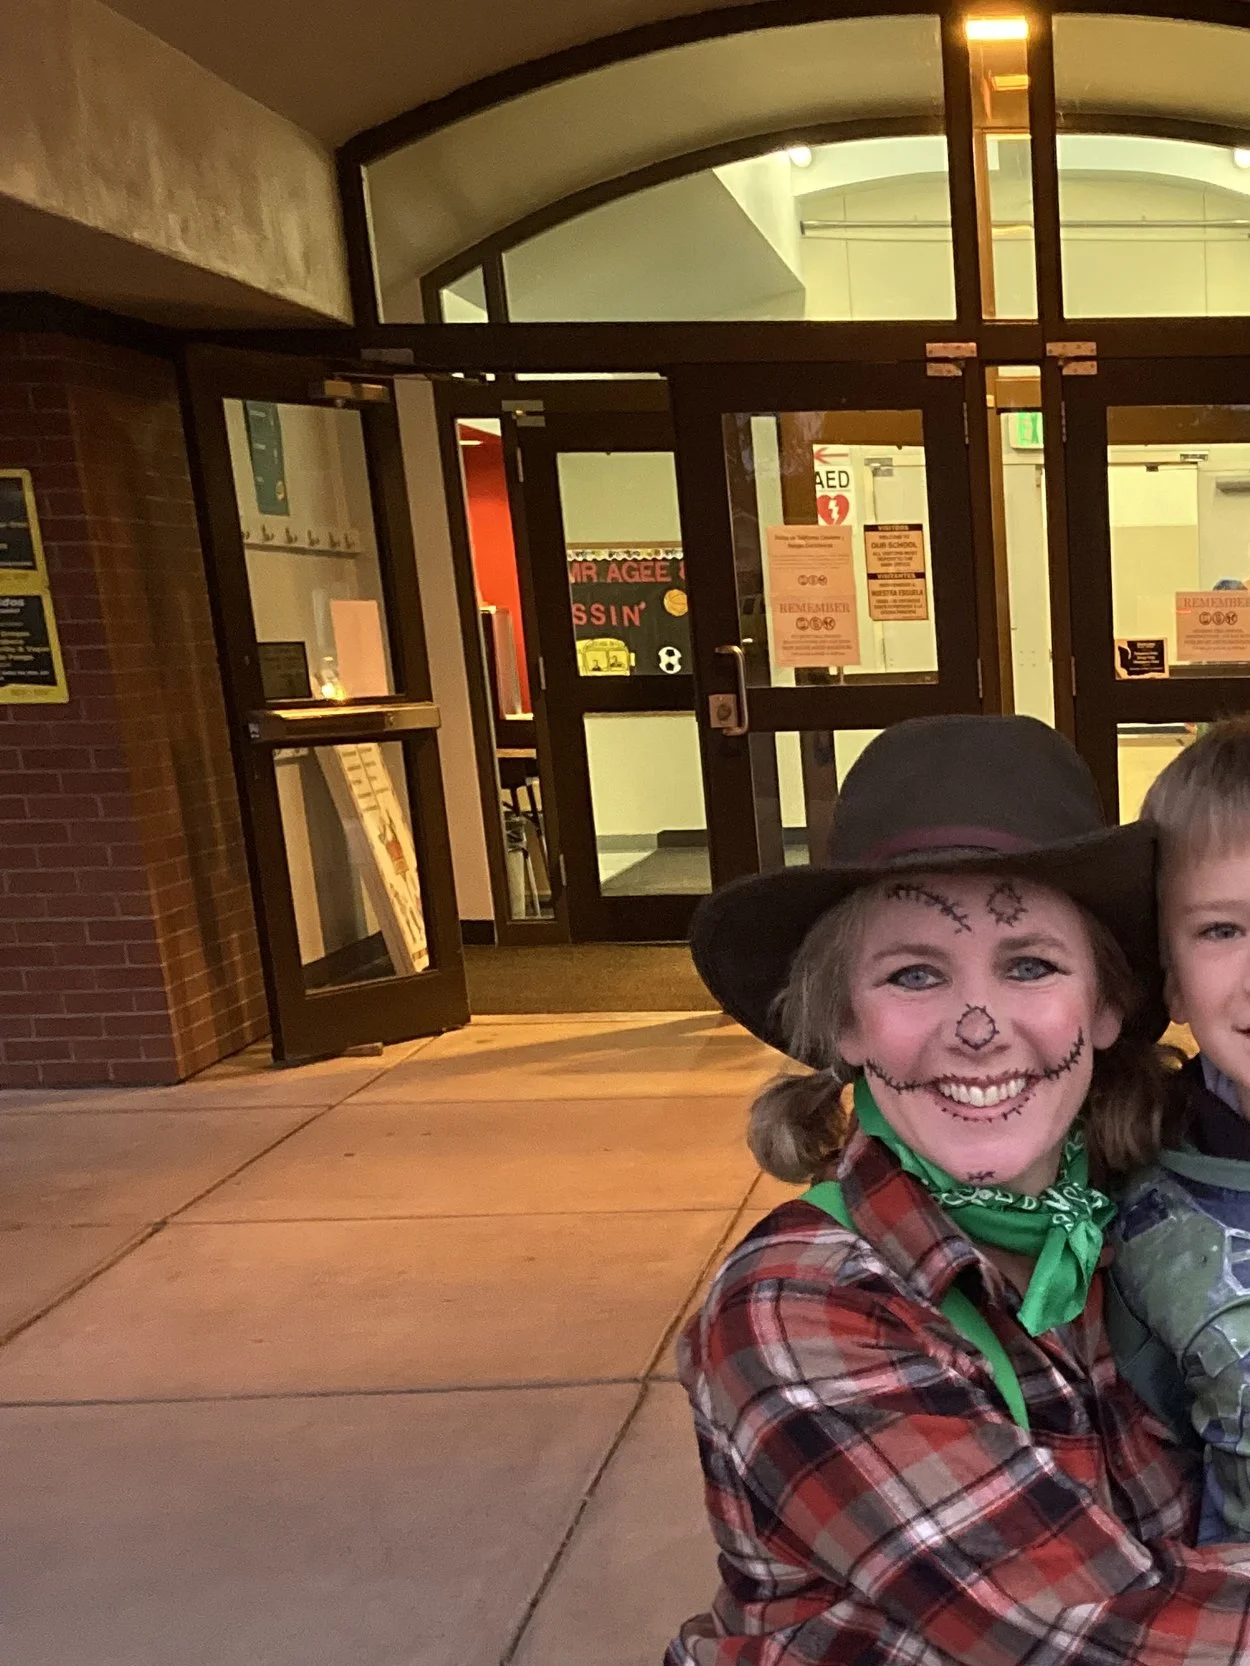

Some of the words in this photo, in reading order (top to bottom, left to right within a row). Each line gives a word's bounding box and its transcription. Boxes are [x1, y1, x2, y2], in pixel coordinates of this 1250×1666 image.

[815, 470, 850, 488] AED
[607, 560, 671, 582] AGEE
[779, 602, 850, 613] REMEMBER
